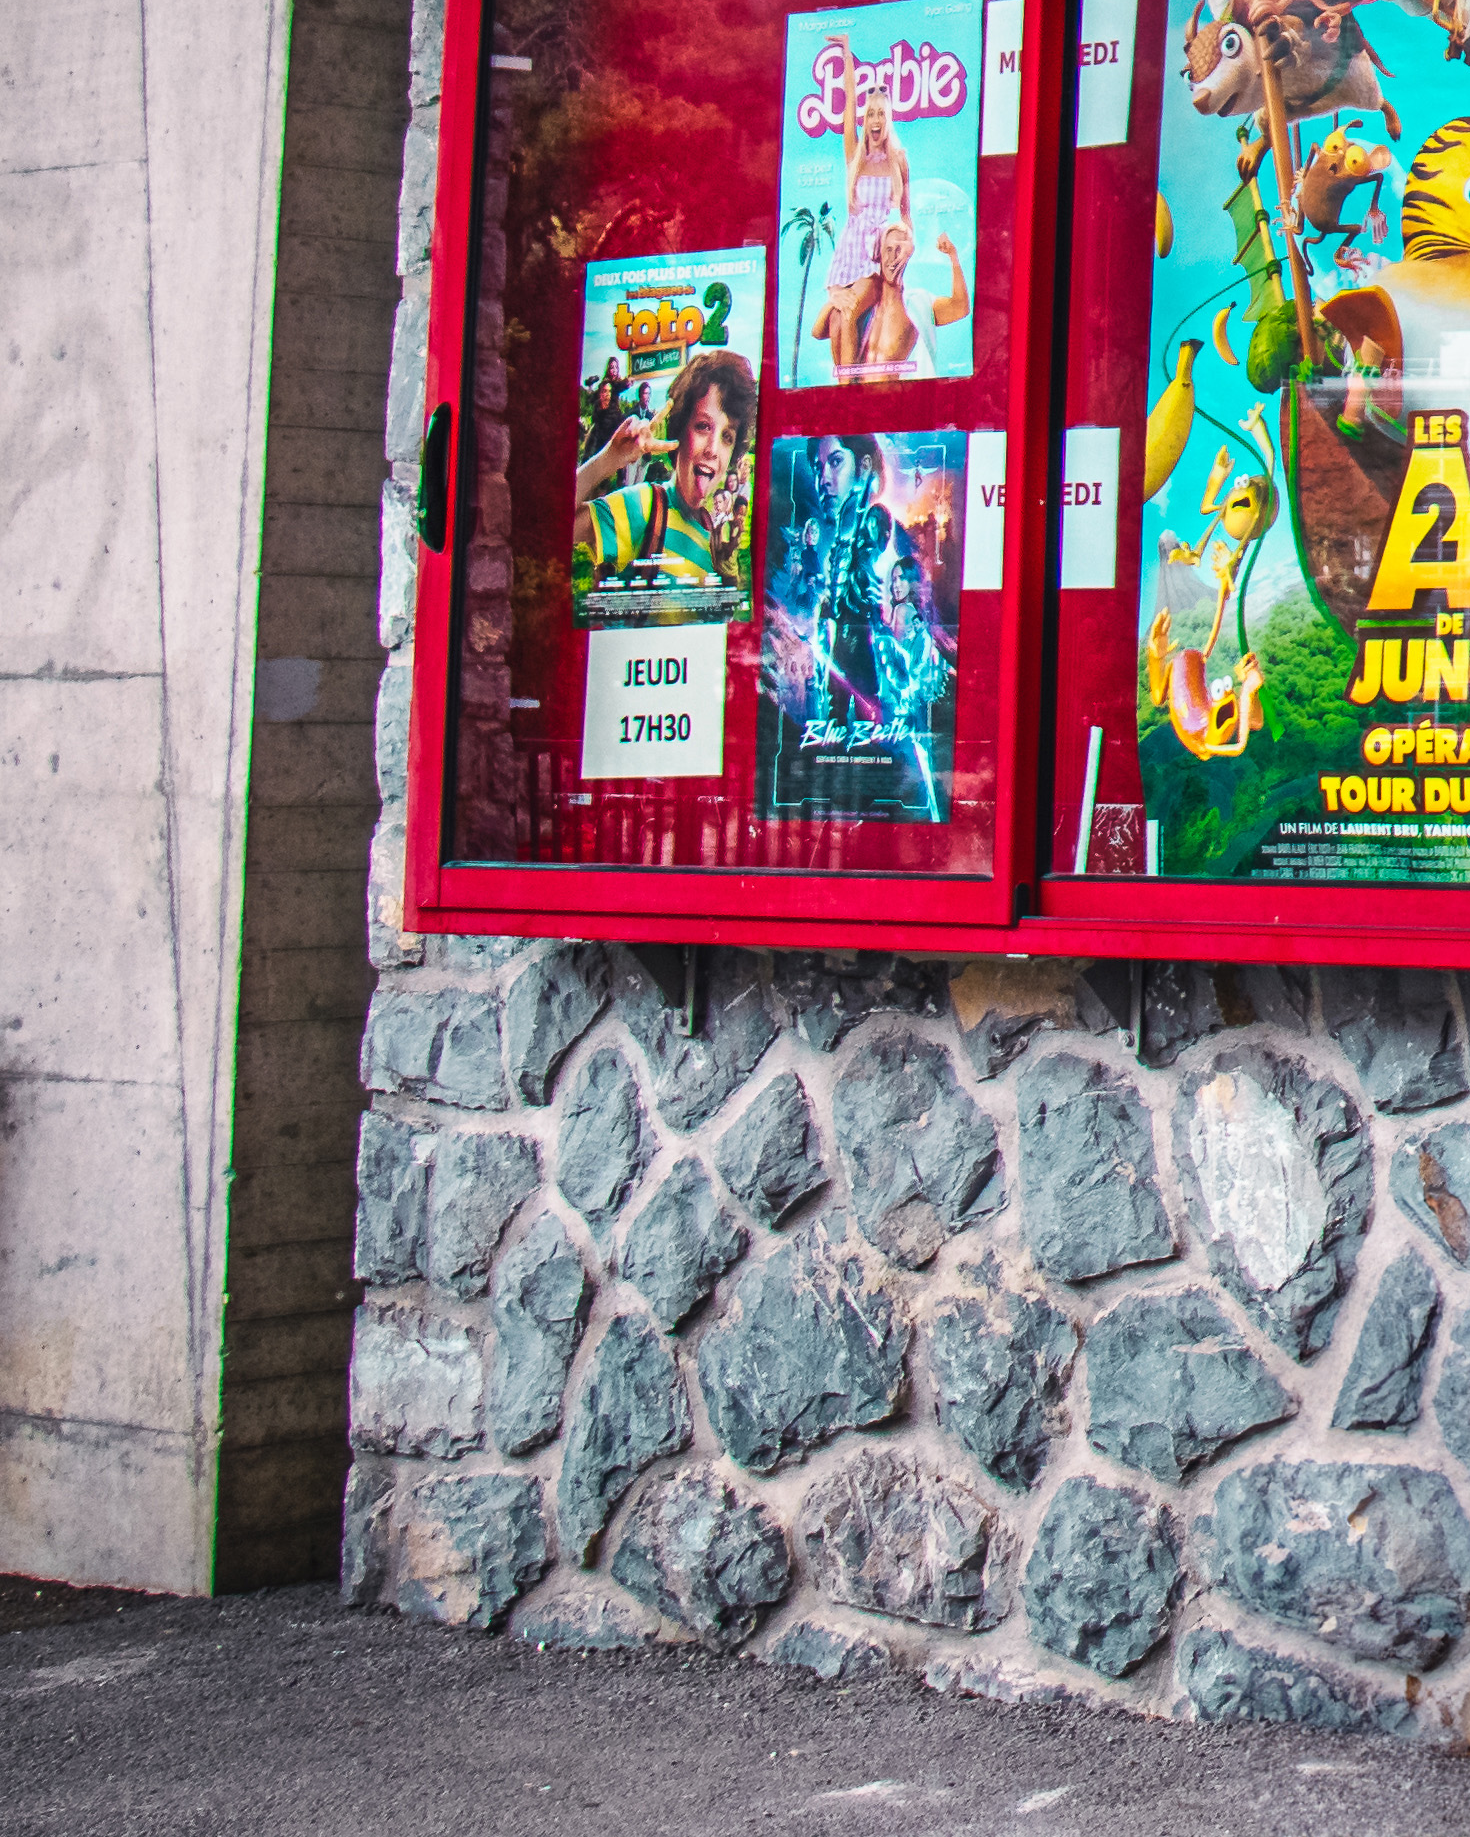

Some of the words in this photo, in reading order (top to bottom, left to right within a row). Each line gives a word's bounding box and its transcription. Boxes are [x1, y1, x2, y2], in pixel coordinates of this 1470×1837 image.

[799, 42, 964, 133] Barbie
[594, 272, 621, 288] DEUX
[622, 270, 647, 285] FOIS
[647, 267, 675, 282] PLUS
[677, 266, 691, 280] DE
[692, 262, 751, 279] VACHERIES
[614, 299, 705, 351] toto
[700, 281, 733, 347] 2
[1414, 415, 1462, 444] LES
[1436, 612, 1464, 636] DE
[624, 657, 688, 687] JEUDI
[620, 713, 692, 744] 17H30
[800, 717, 848, 752] Blue
[846, 715, 912, 753] Beetle
[1320, 775, 1417, 813] TOUR
[1279, 822, 1297, 835] UN
[1299, 822, 1322, 835] FILM
[1324, 822, 1339, 835] DE
[1339, 822, 1392, 836] LAURENT
[1393, 823, 1423, 838] BRU,
